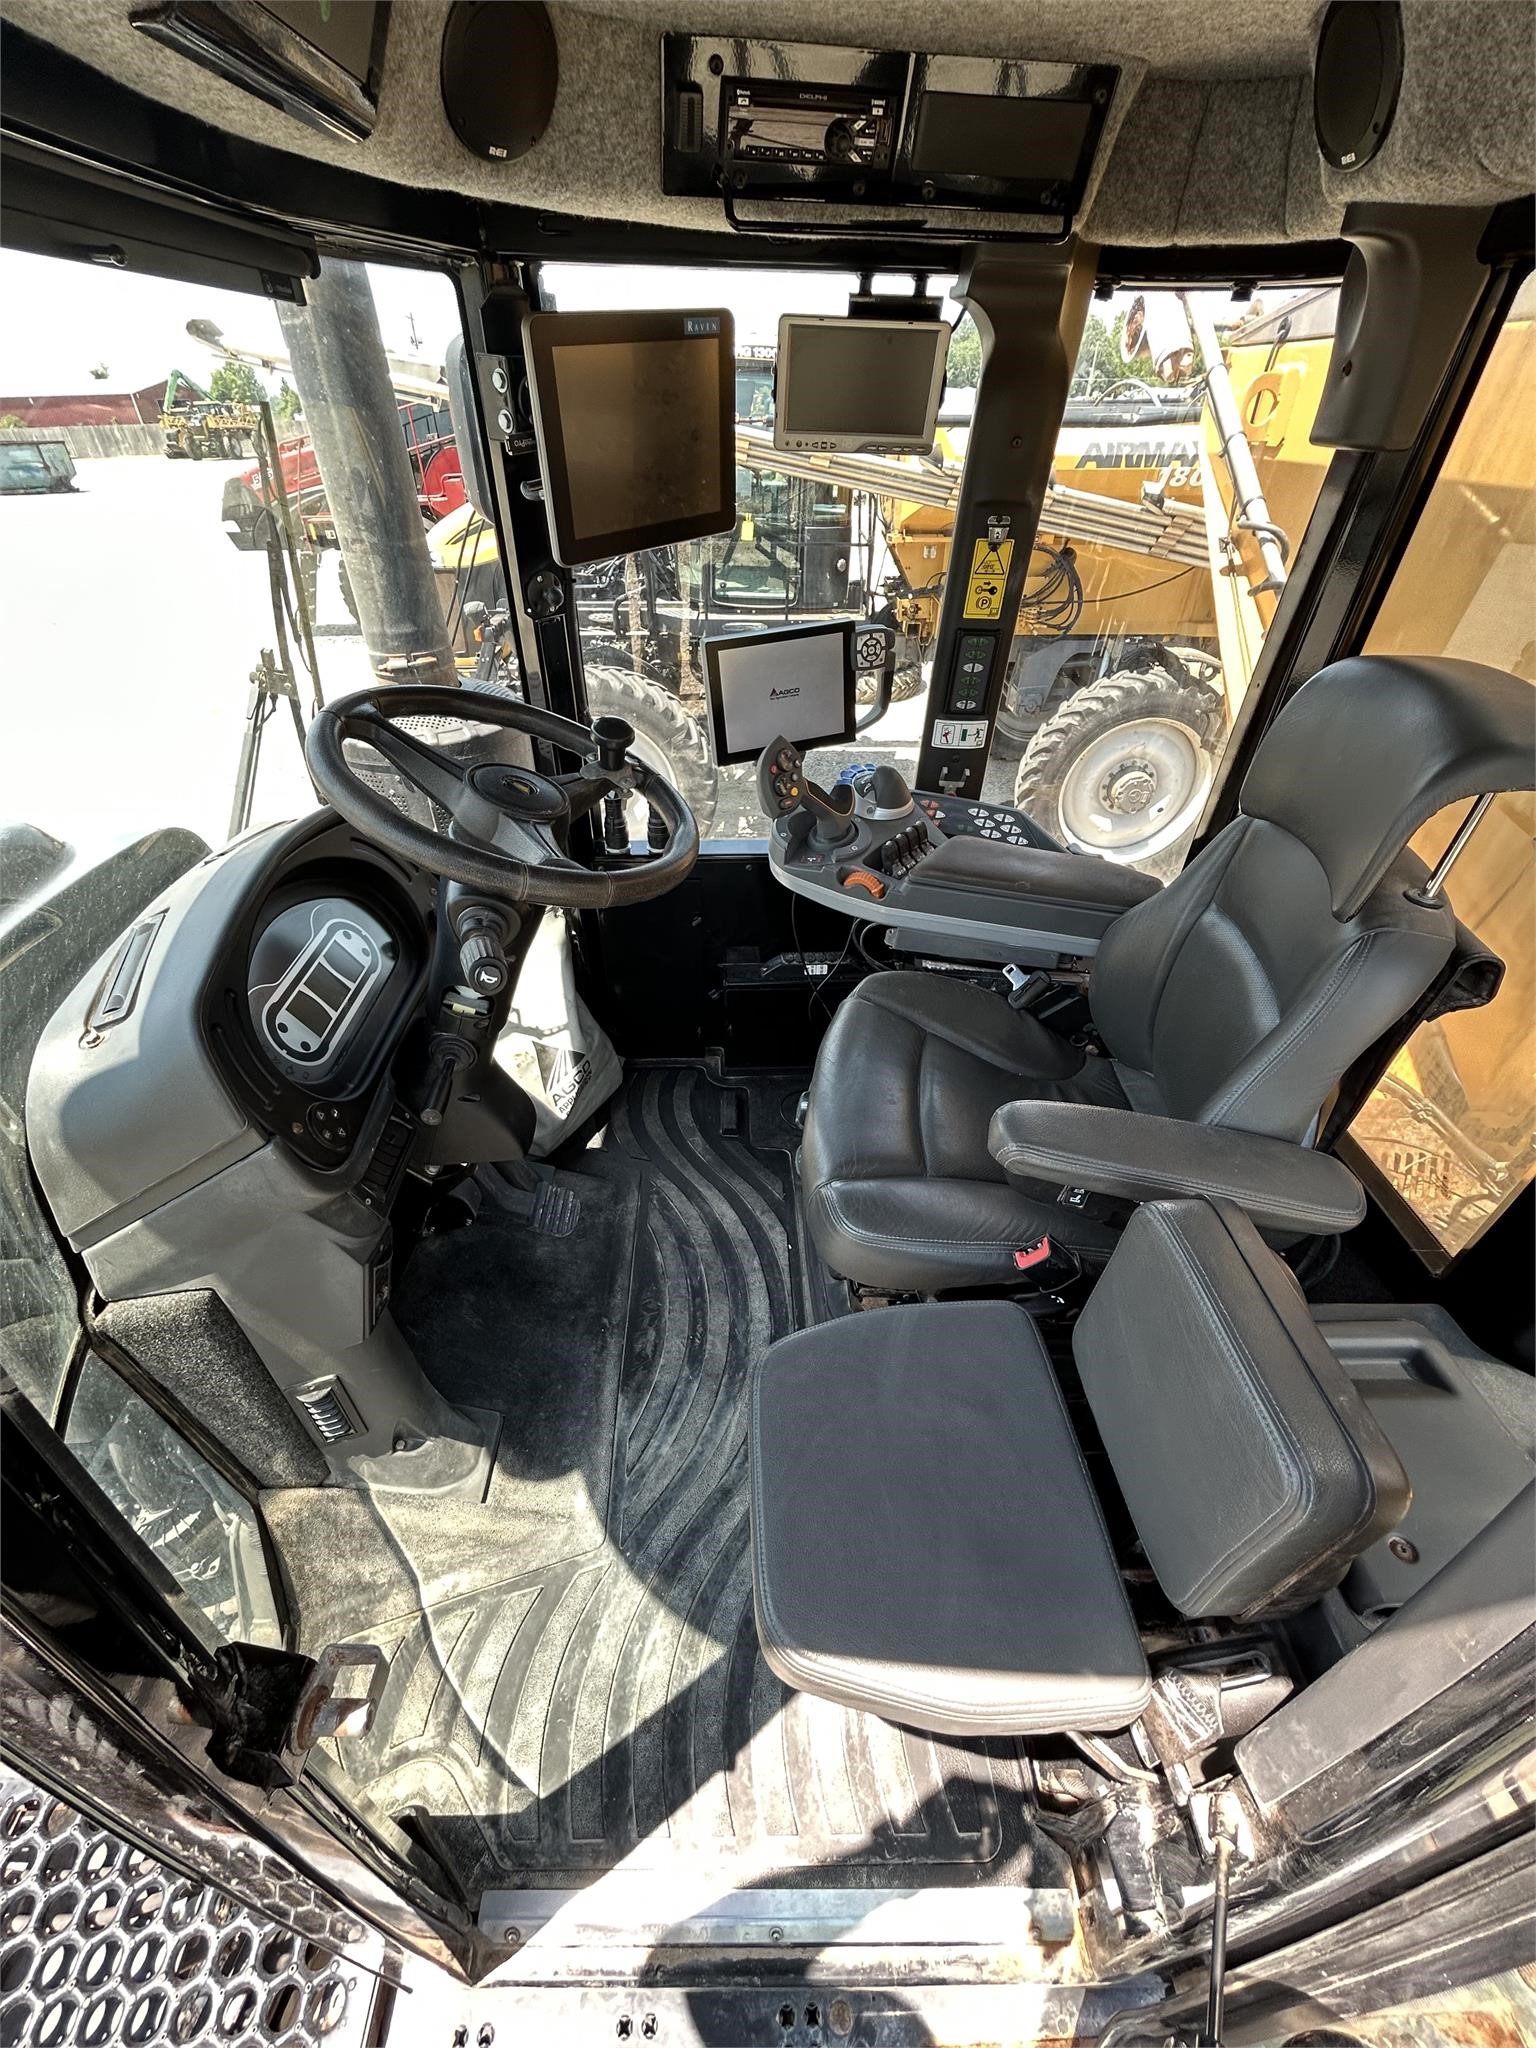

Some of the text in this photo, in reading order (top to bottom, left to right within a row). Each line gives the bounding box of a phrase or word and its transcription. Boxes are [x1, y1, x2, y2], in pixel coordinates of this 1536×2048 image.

[799, 92, 828, 101] DELPHI
[687, 320, 718, 333] RAVEN
[552, 1060, 590, 1107] AGCO
